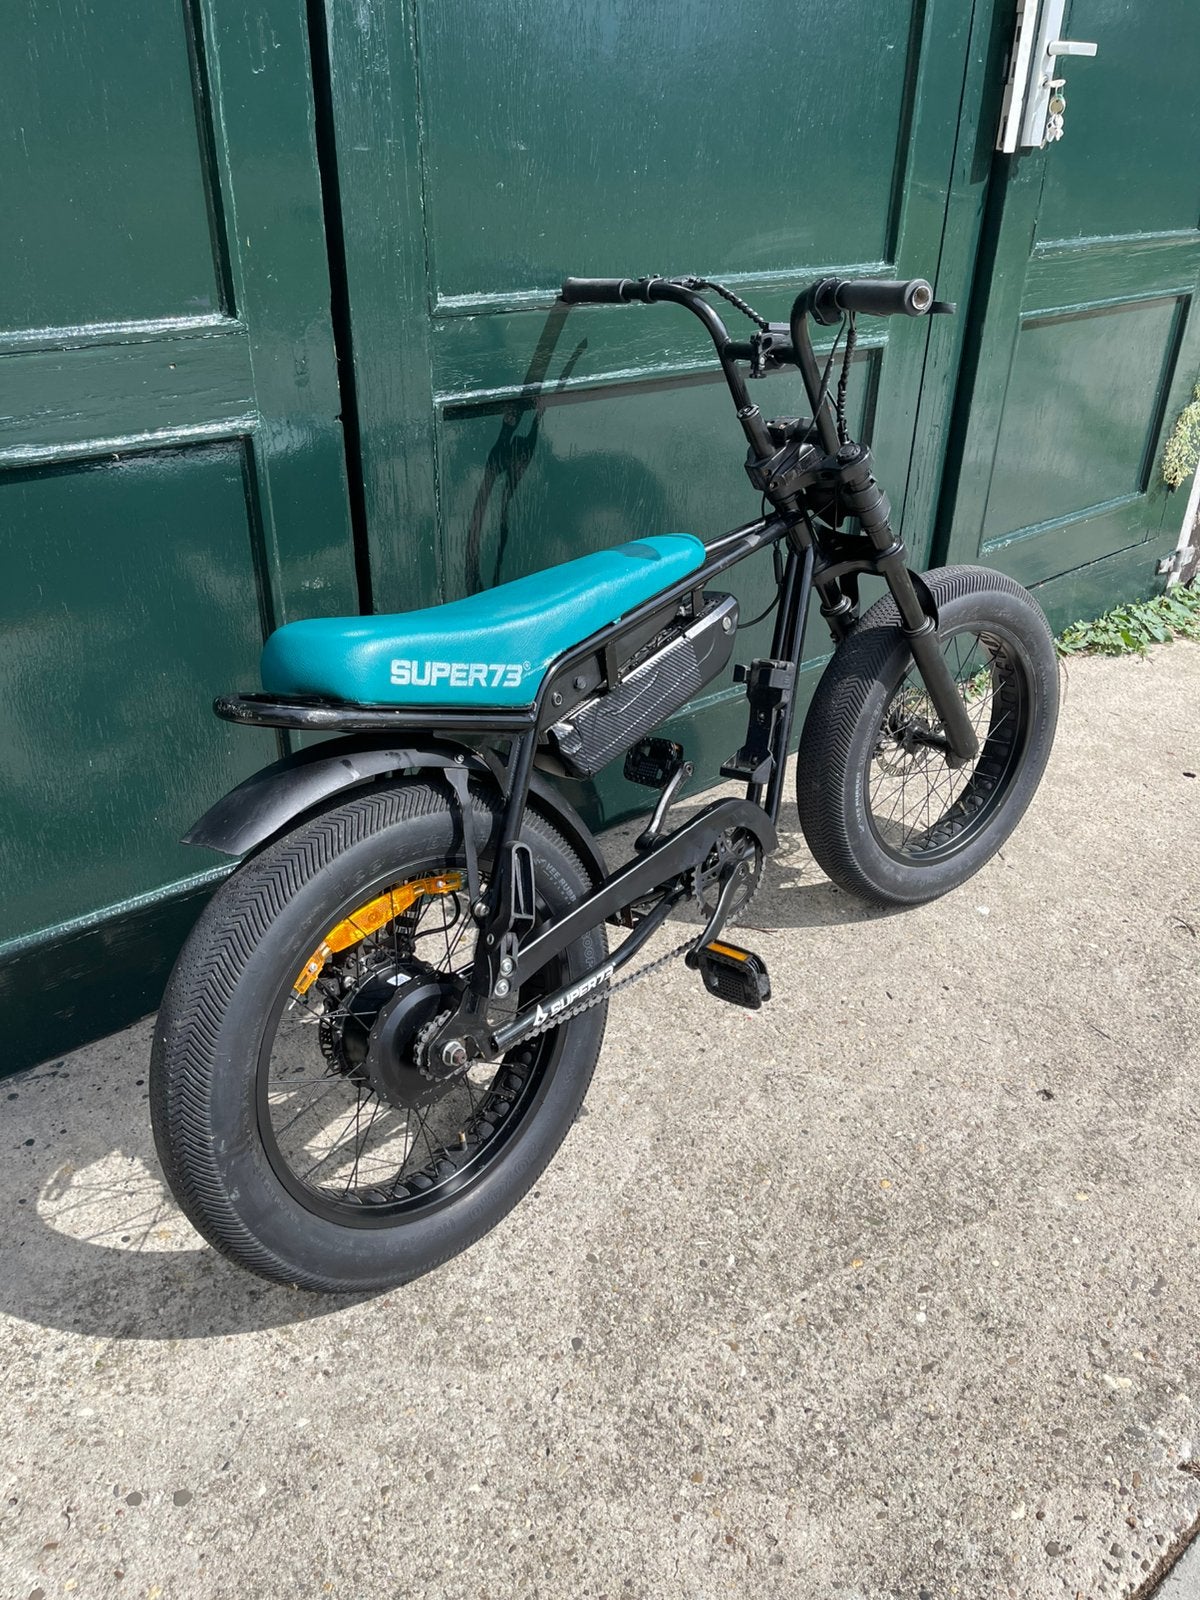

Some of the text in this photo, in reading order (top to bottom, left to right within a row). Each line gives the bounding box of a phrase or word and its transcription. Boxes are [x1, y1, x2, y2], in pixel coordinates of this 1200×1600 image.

[390, 659, 524, 687] SUPER73
[545, 862, 561, 880] VEE
[559, 878, 577, 902] RUBB
[550, 965, 614, 1017] SUPER73
